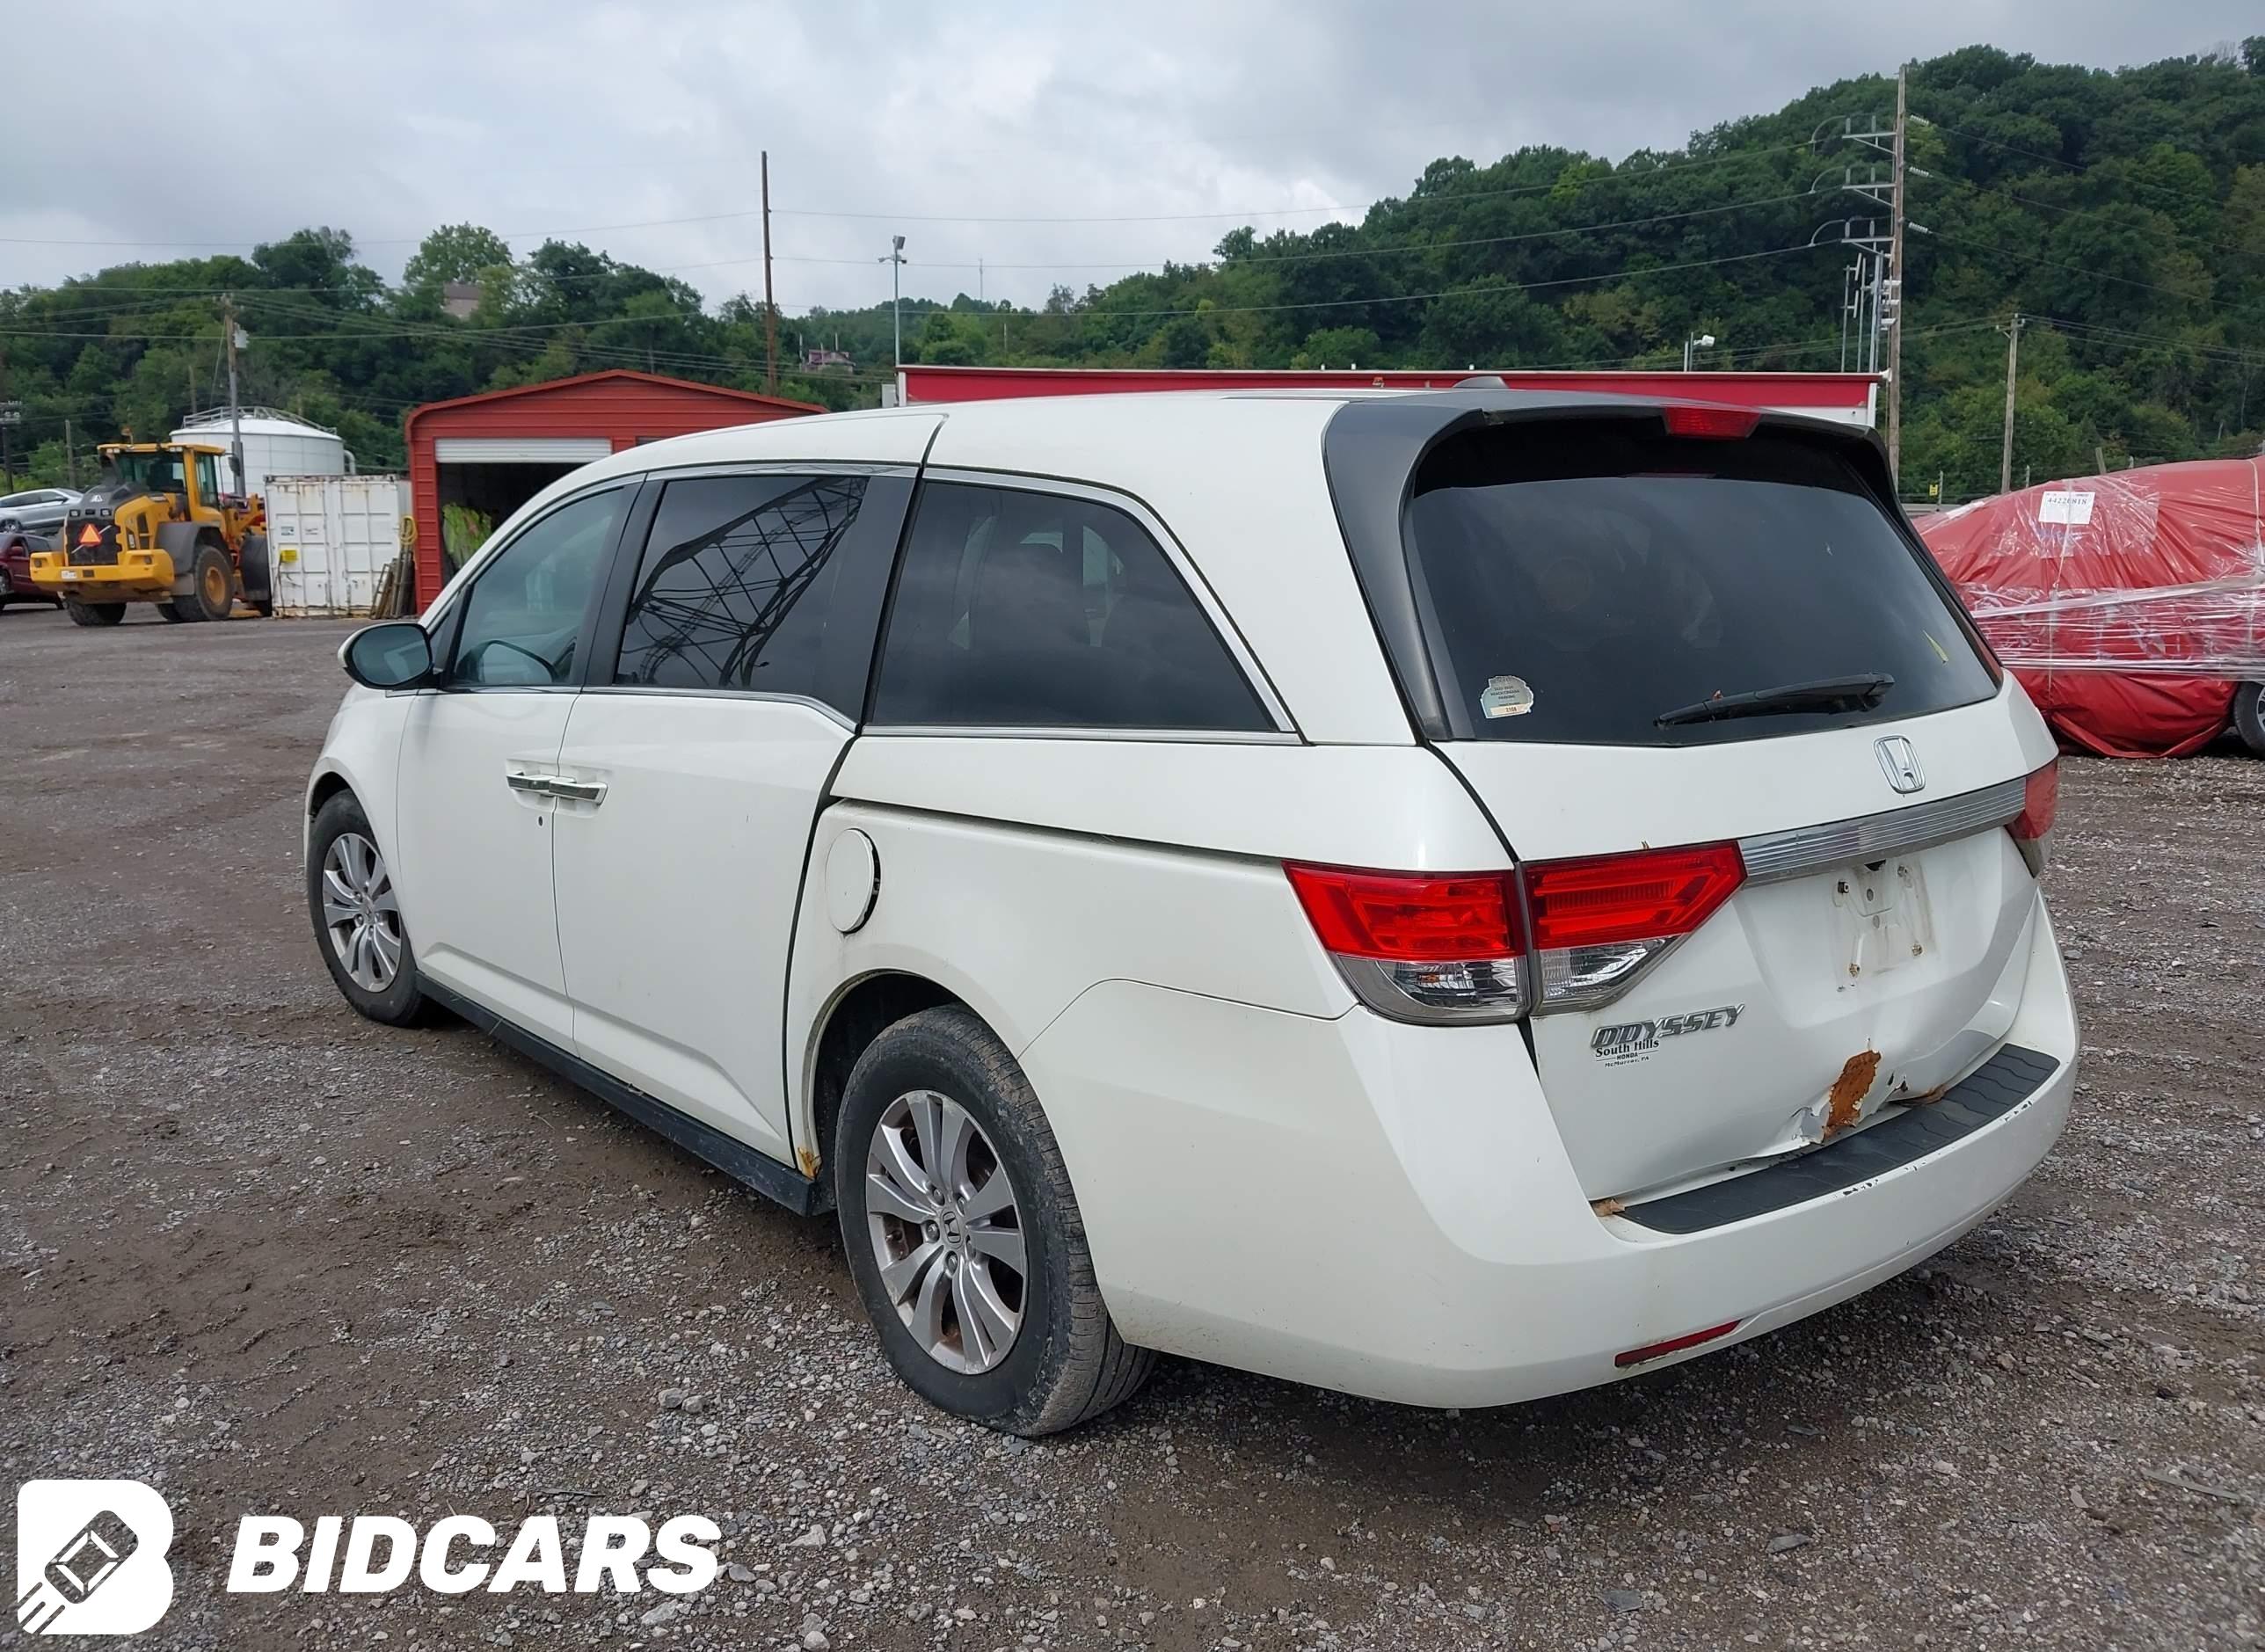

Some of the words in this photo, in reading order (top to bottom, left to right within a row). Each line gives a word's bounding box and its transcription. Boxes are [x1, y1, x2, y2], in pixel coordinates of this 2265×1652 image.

[1591, 1003, 1745, 1048] ODYSSEY
[1596, 1044, 1630, 1057] South
[1634, 1038, 1660, 1051] Hills
